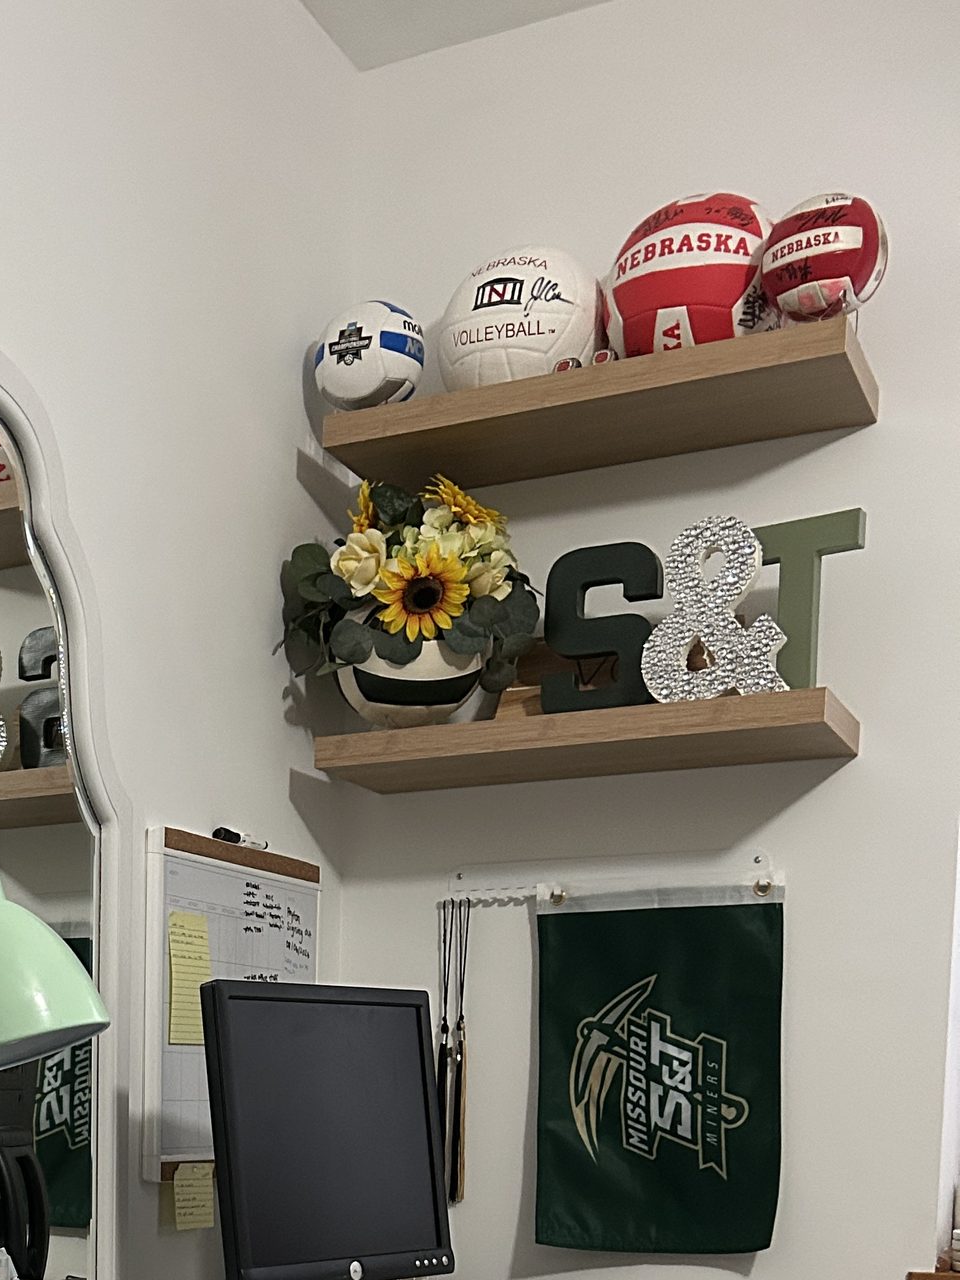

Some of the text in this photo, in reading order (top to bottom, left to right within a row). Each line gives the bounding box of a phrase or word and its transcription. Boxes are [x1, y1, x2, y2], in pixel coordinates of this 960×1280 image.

[471, 256, 548, 279] NEBRASKA
[615, 232, 752, 281] NEBRASKA
[771, 231, 841, 264] NEBRASKA
[453, 320, 546, 348] VOLLEYBALL
[626, 1024, 648, 1151] MISSOURI
[649, 1020, 693, 1140] S&T
[706, 1060, 719, 1146] MINERS
